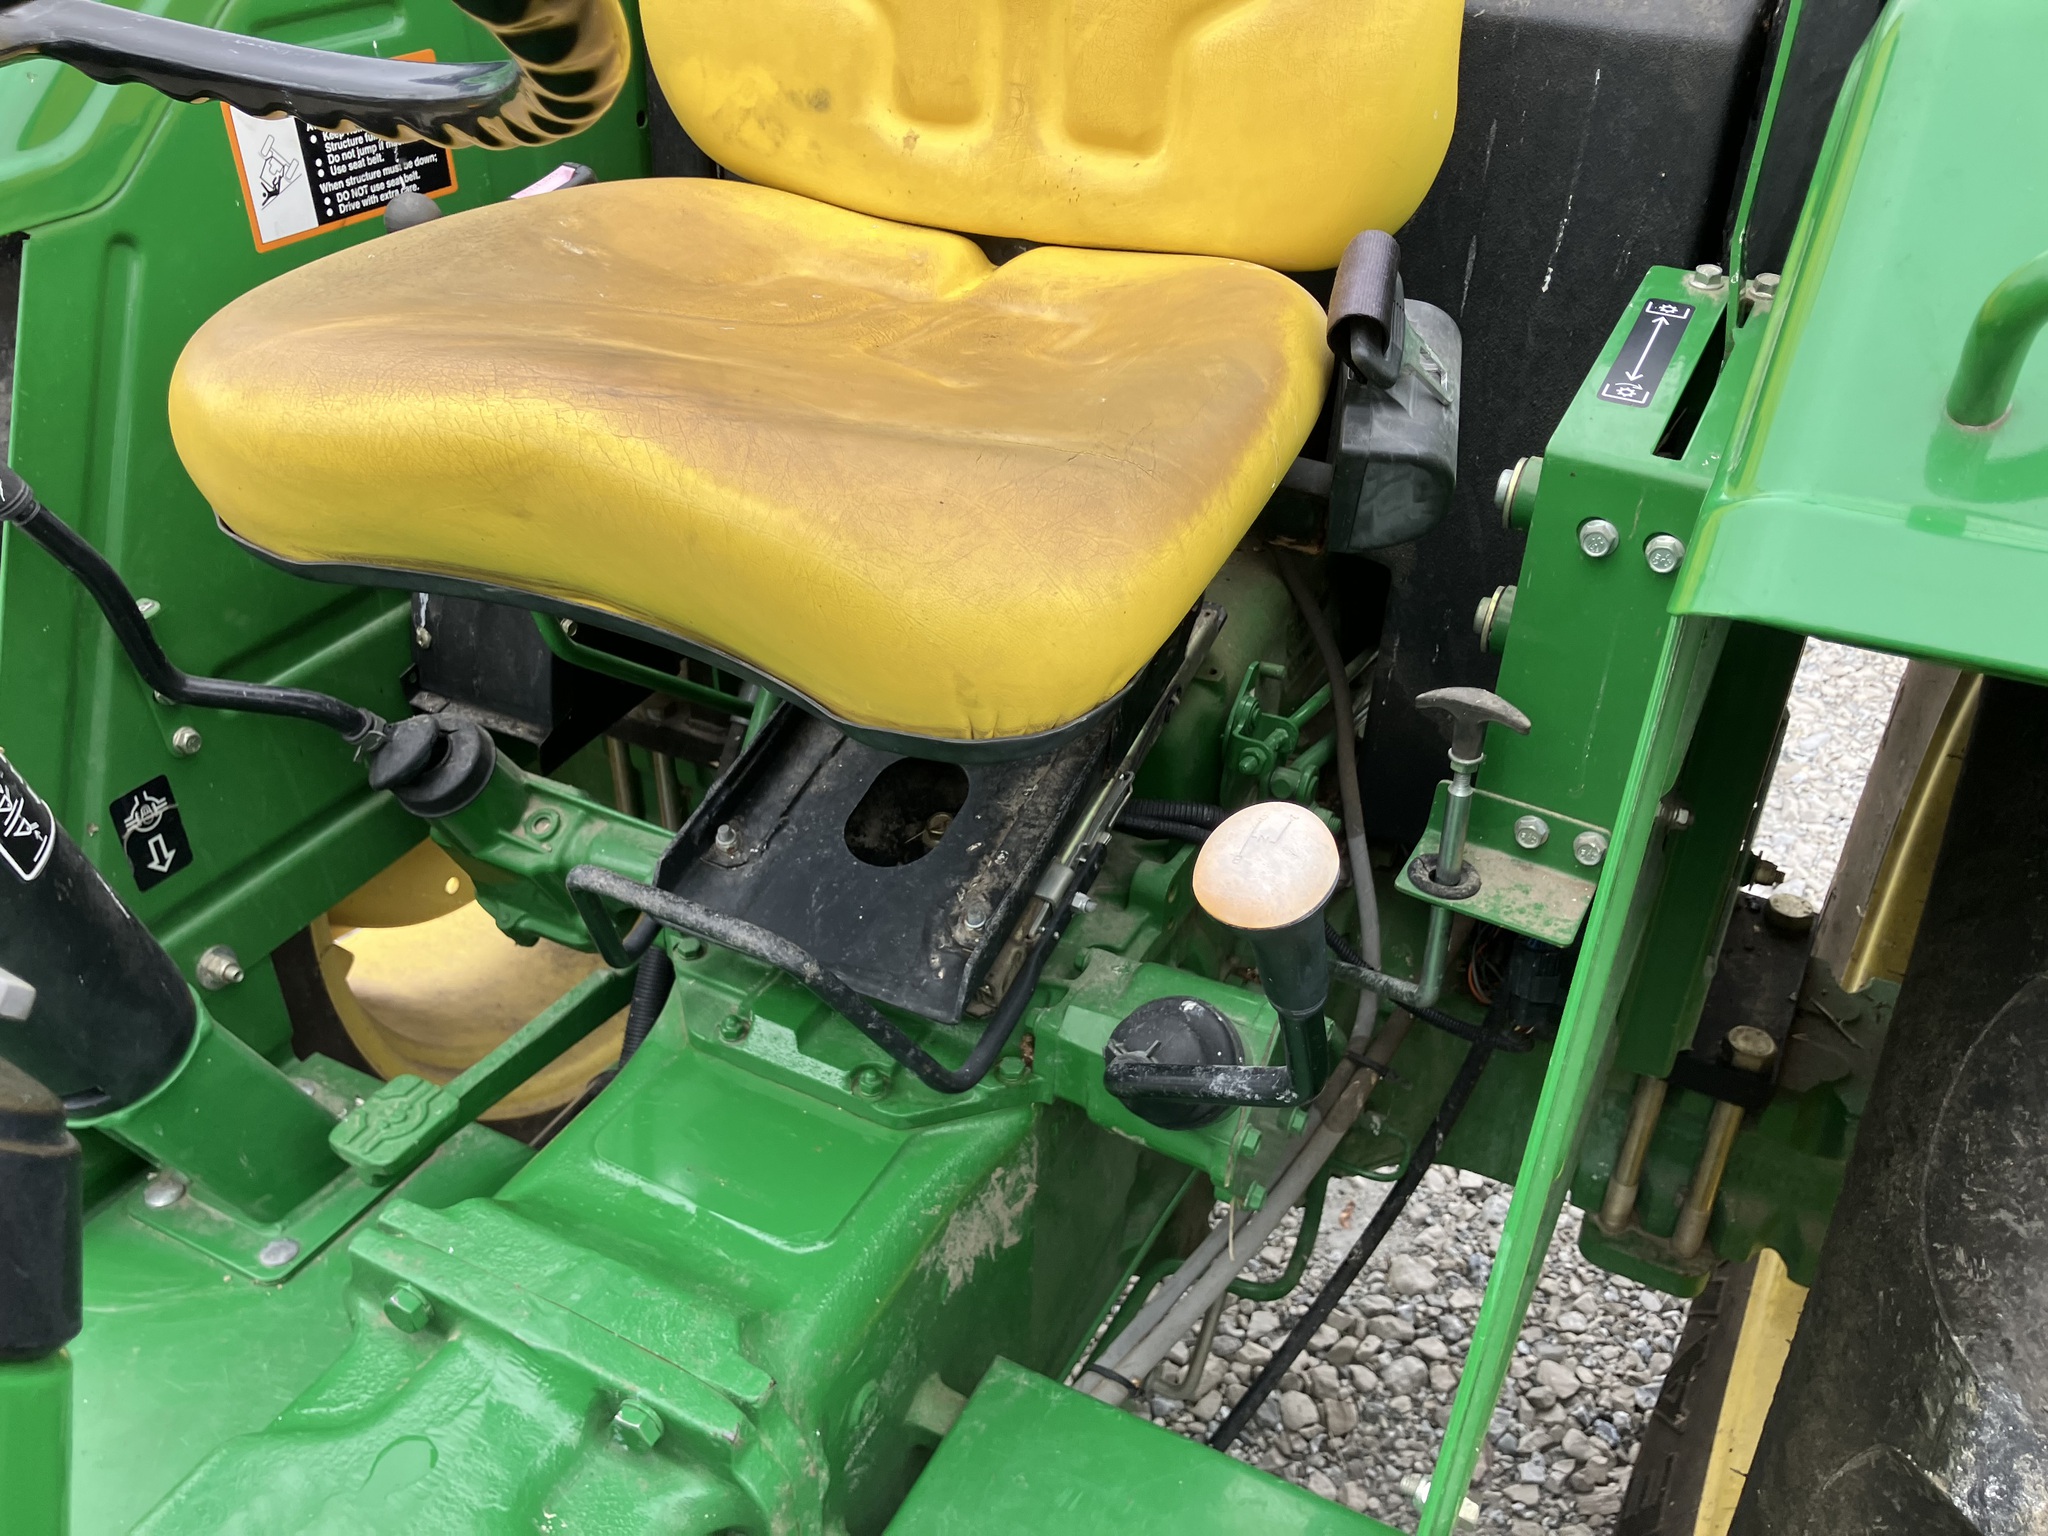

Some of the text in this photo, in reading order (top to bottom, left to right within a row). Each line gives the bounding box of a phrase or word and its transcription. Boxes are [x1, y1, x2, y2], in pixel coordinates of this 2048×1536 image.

[325, 135, 364, 153] Structure
[327, 153, 340, 165] Do
[341, 148, 356, 161] not
[356, 144, 378, 159] jump
[330, 153, 385, 176] Use seat belt.
[319, 180, 345, 194] When
[345, 169, 382, 187] structure
[382, 163, 403, 176] must
[403, 160, 413, 170] be
[336, 190, 350, 203] DO
[350, 184, 369, 199] NOT
[370, 182, 385, 193] use
[403, 170, 421, 183] belt.
[338, 201, 361, 214] Drive
[361, 194, 379, 207] with
[379, 189, 400, 202] extra
